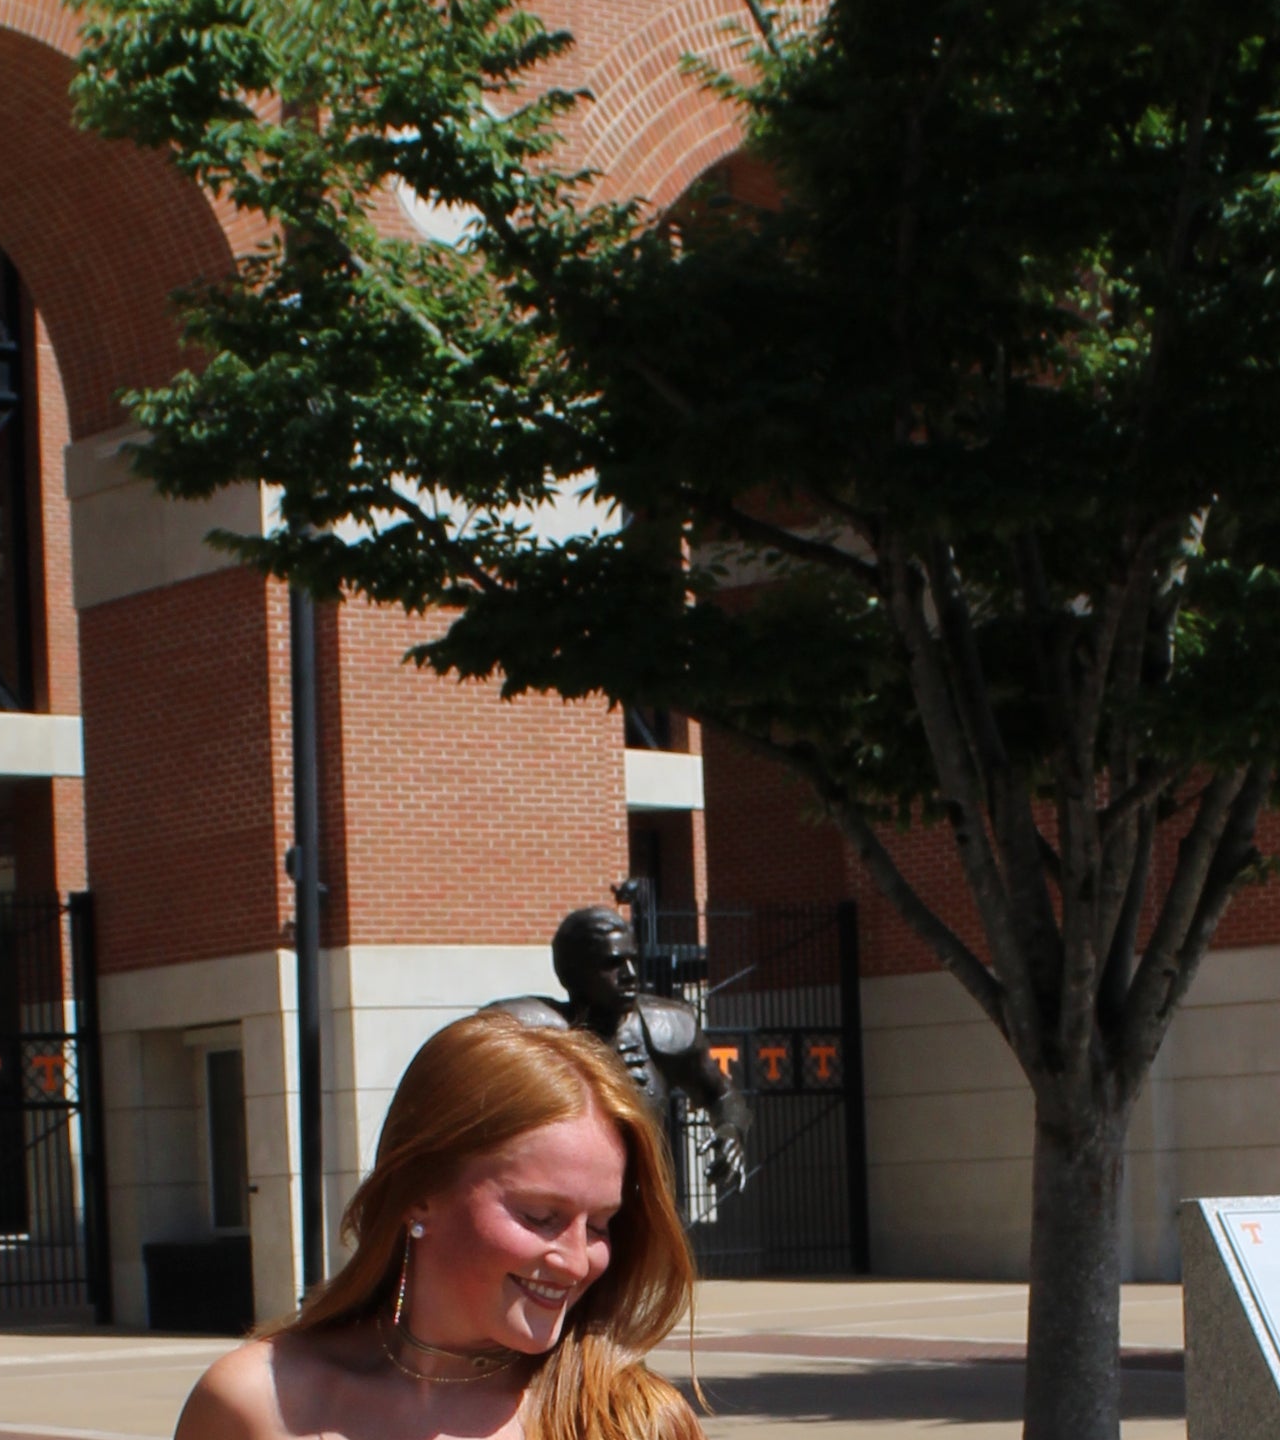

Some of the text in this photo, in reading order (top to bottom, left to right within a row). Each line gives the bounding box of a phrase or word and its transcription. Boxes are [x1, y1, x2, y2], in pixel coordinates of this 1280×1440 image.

[32, 1056, 65, 1091] T
[758, 1045, 787, 1080] T
[809, 1045, 836, 1079] T
[1241, 1223, 1263, 1244] T
